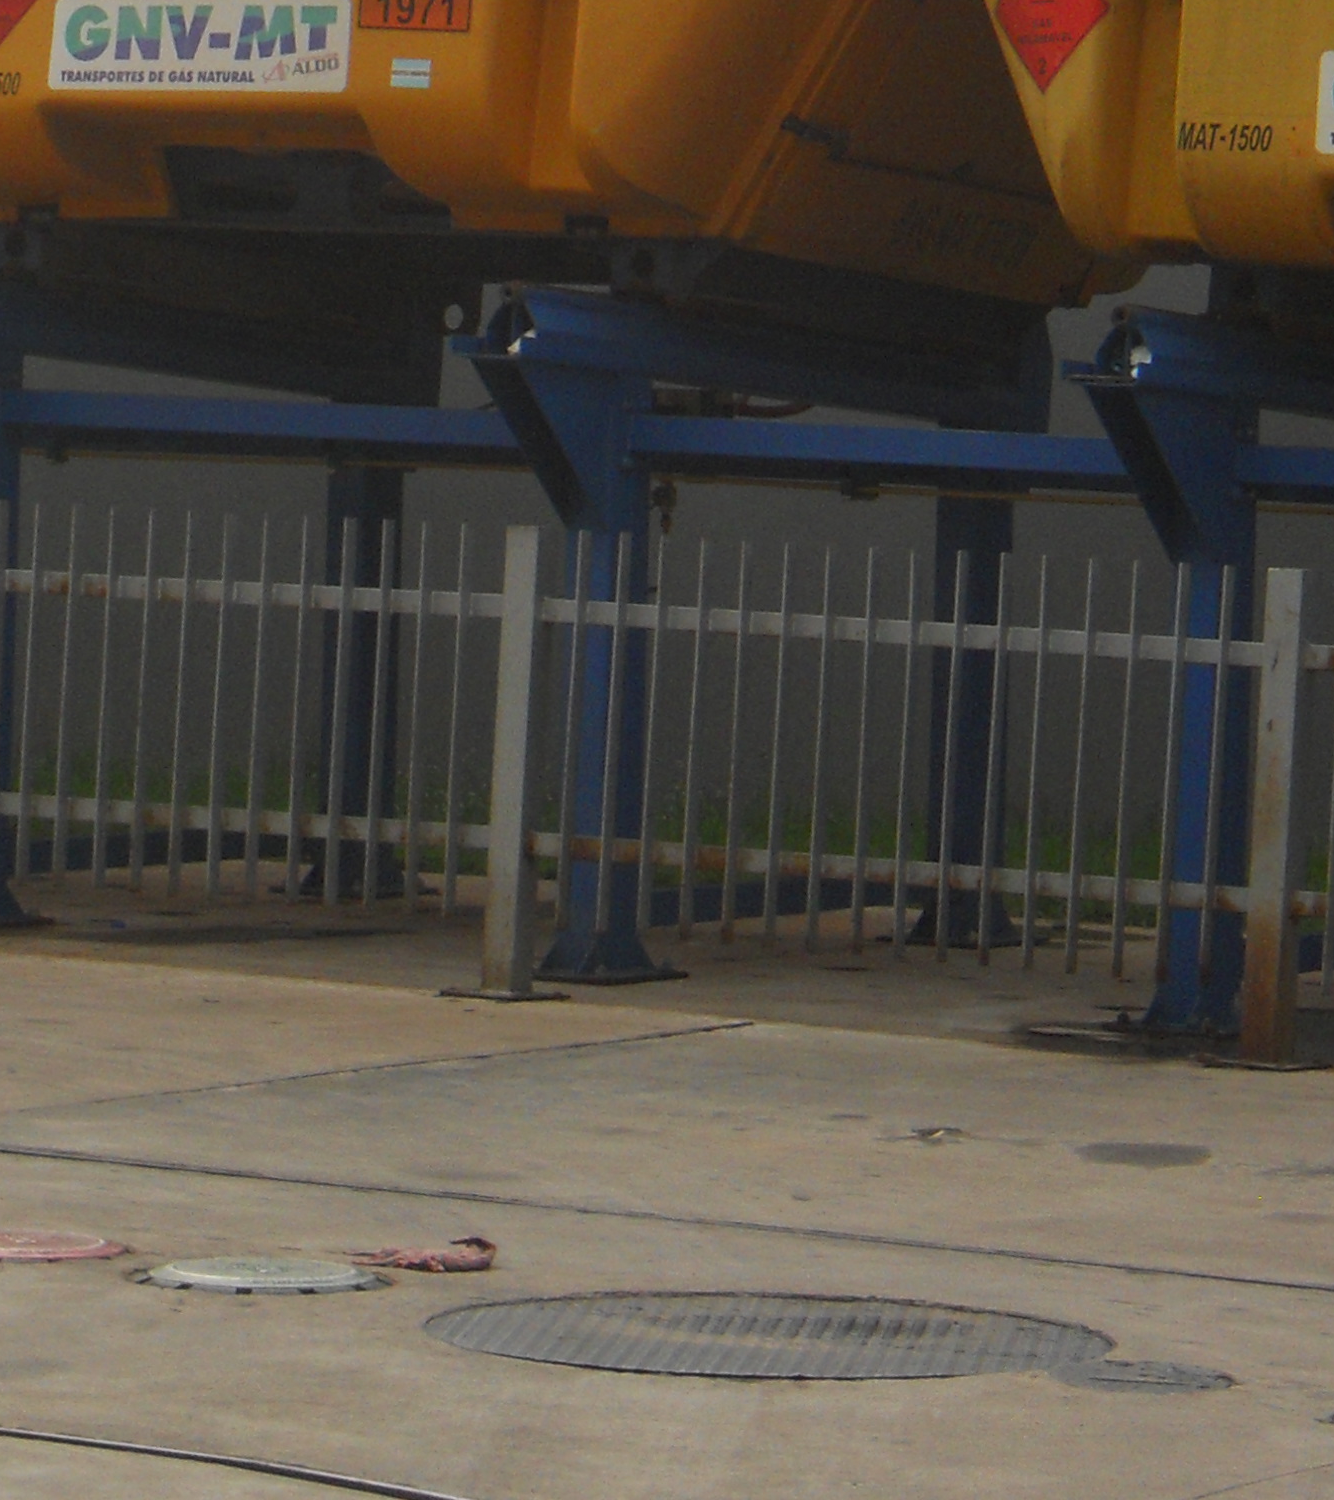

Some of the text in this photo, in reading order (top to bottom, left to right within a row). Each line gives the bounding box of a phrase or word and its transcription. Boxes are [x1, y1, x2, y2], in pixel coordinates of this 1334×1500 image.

[64, 4, 339, 62] GNV-MT
[292, 56, 340, 77] ALDO
[1038, 57, 1048, 75] 2
[60, 70, 145, 83] TRANSPORTES
[148, 71, 164, 83] DE
[197, 71, 255, 84] NATURAL
[1177, 122, 1274, 153] MAT-1500
